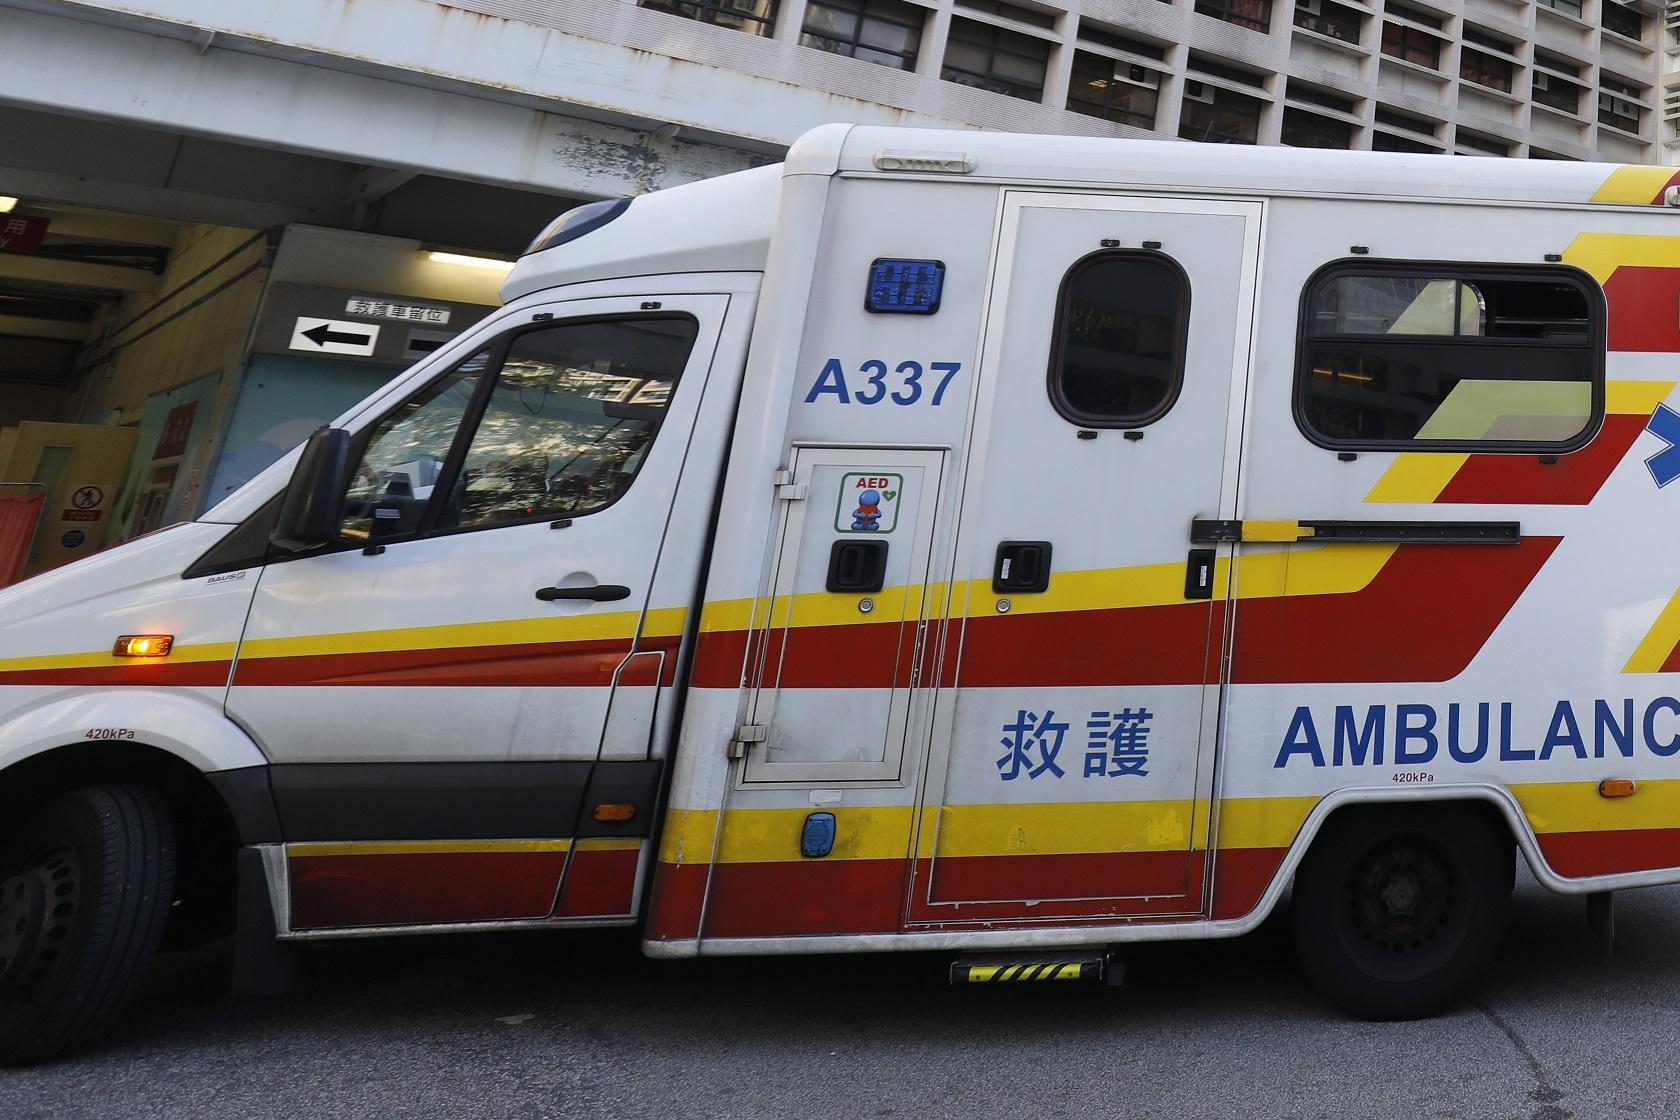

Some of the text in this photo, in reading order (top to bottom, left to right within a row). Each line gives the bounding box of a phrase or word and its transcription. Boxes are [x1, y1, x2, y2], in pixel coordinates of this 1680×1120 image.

[804, 358, 962, 406] A337
[856, 477, 889, 489] AED
[85, 728, 135, 740] 420kPa
[996, 707, 1154, 781] 救護
[1391, 772, 1435, 783] 420kPa
